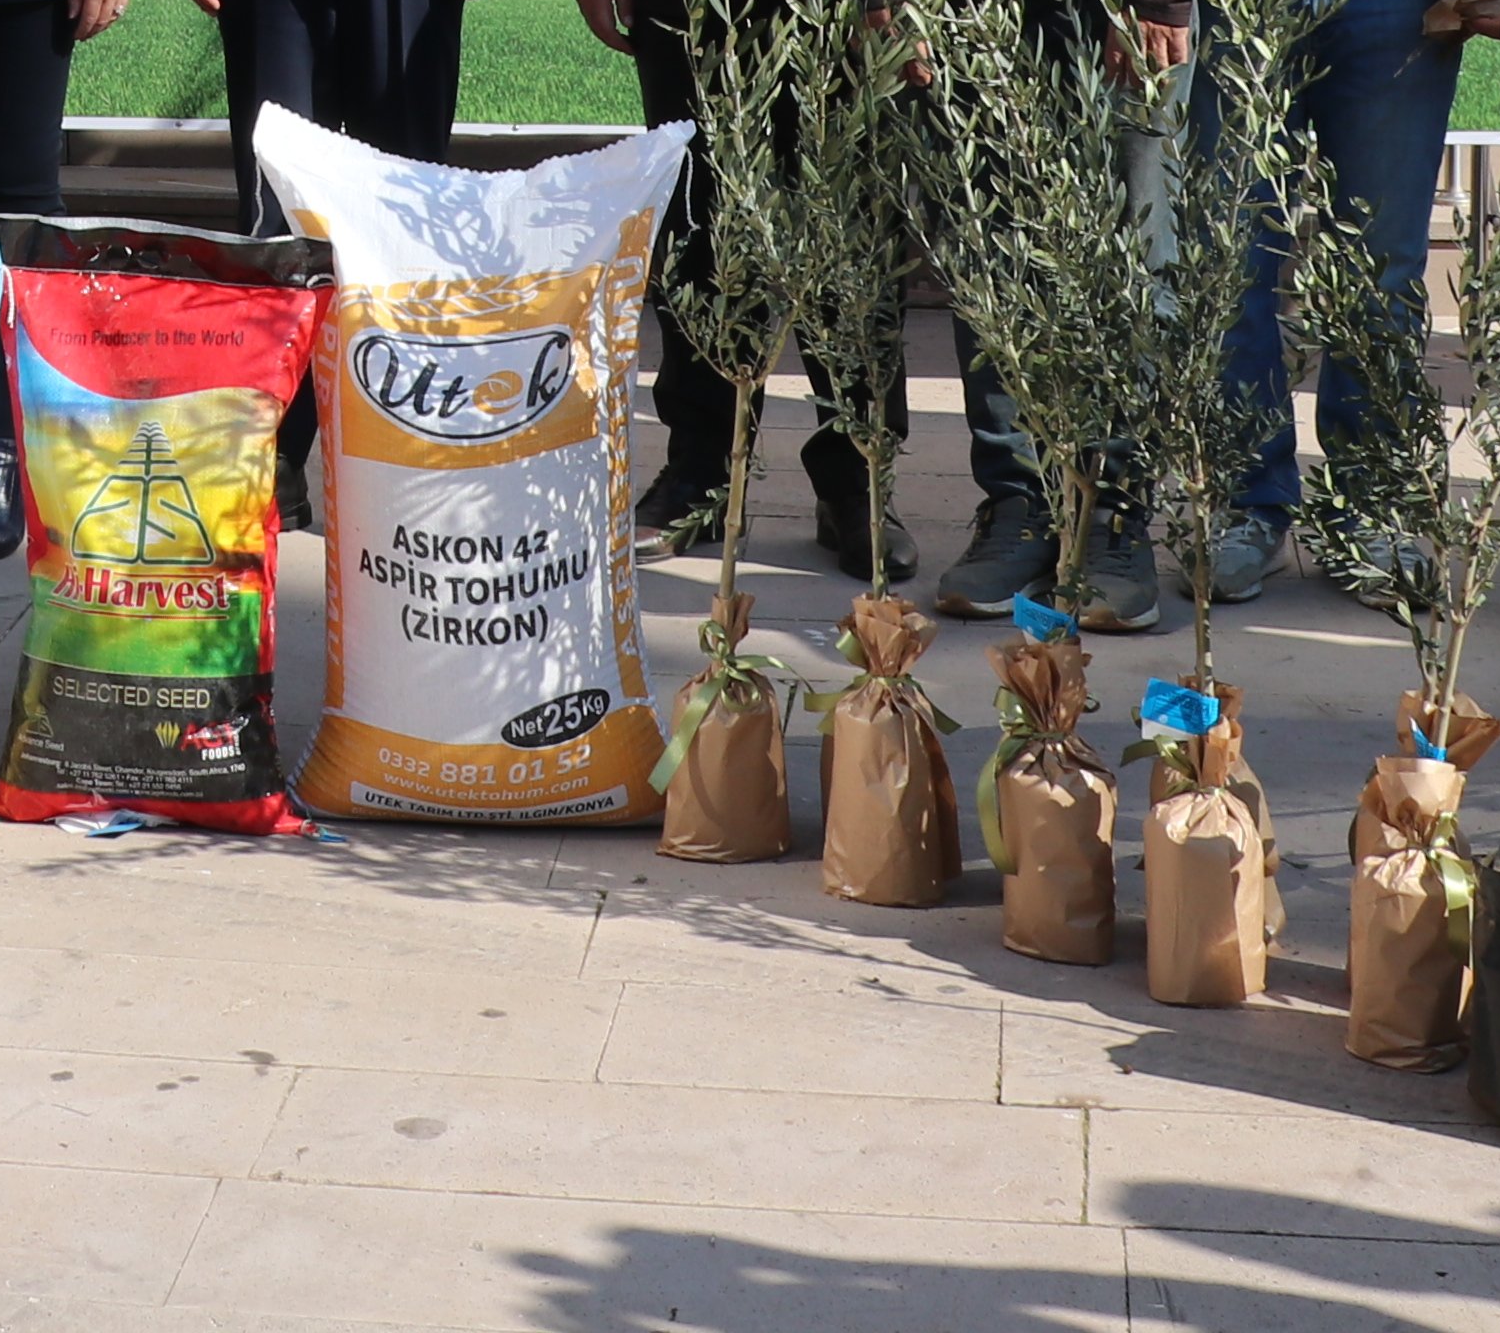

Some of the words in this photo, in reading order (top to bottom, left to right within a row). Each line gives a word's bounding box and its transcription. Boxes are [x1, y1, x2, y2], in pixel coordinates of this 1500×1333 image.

[50, 328, 87, 346] From
[91, 329, 149, 347] Producer
[154, 329, 169, 346] to
[172, 329, 196, 346] the
[201, 329, 245, 347] World
[392, 524, 504, 565] ASKON
[511, 528, 550, 564] 42
[358, 547, 438, 602] ASPİR
[444, 548, 589, 606] TOHUMU
[401, 603, 550, 646] (ZİRKON)
[52, 676, 150, 707] SELECTED
[156, 688, 211, 709] SEED
[510, 717, 543, 739] Net
[543, 695, 582, 738] 25
[582, 694, 605, 718] Kg
[201, 745, 235, 761] FOODS
[378, 747, 431, 778] 0332
[440, 762, 497, 785] 881
[508, 758, 545, 785] 01
[556, 743, 592, 775] 52
[383, 772, 589, 801] www.utektohum.com
[364, 791, 403, 810] UTEK
[409, 803, 453, 817] TARIM
[519, 796, 615, 820] ILGIN/KONYA
